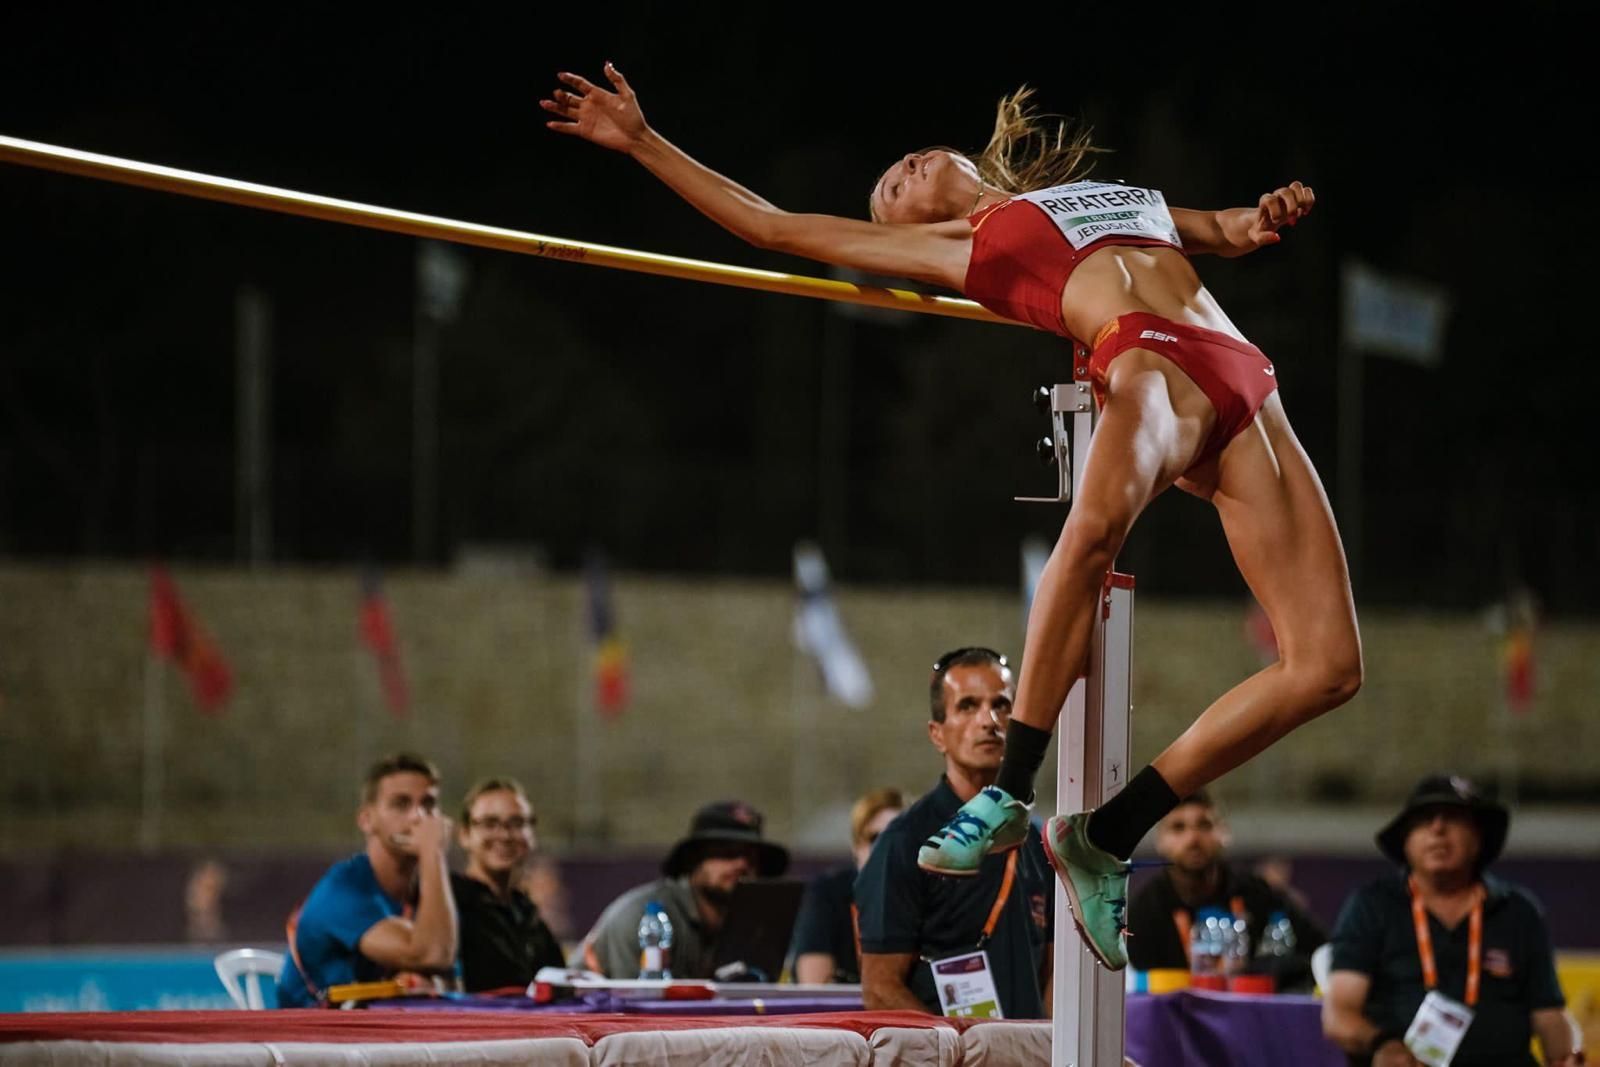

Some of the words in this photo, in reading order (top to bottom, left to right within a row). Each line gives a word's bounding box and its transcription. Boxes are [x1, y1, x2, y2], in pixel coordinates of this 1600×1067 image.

[1092, 212, 1115, 222] RUN
[1077, 220, 1143, 241] JERUSALE
[1140, 330, 1178, 342] ESP
